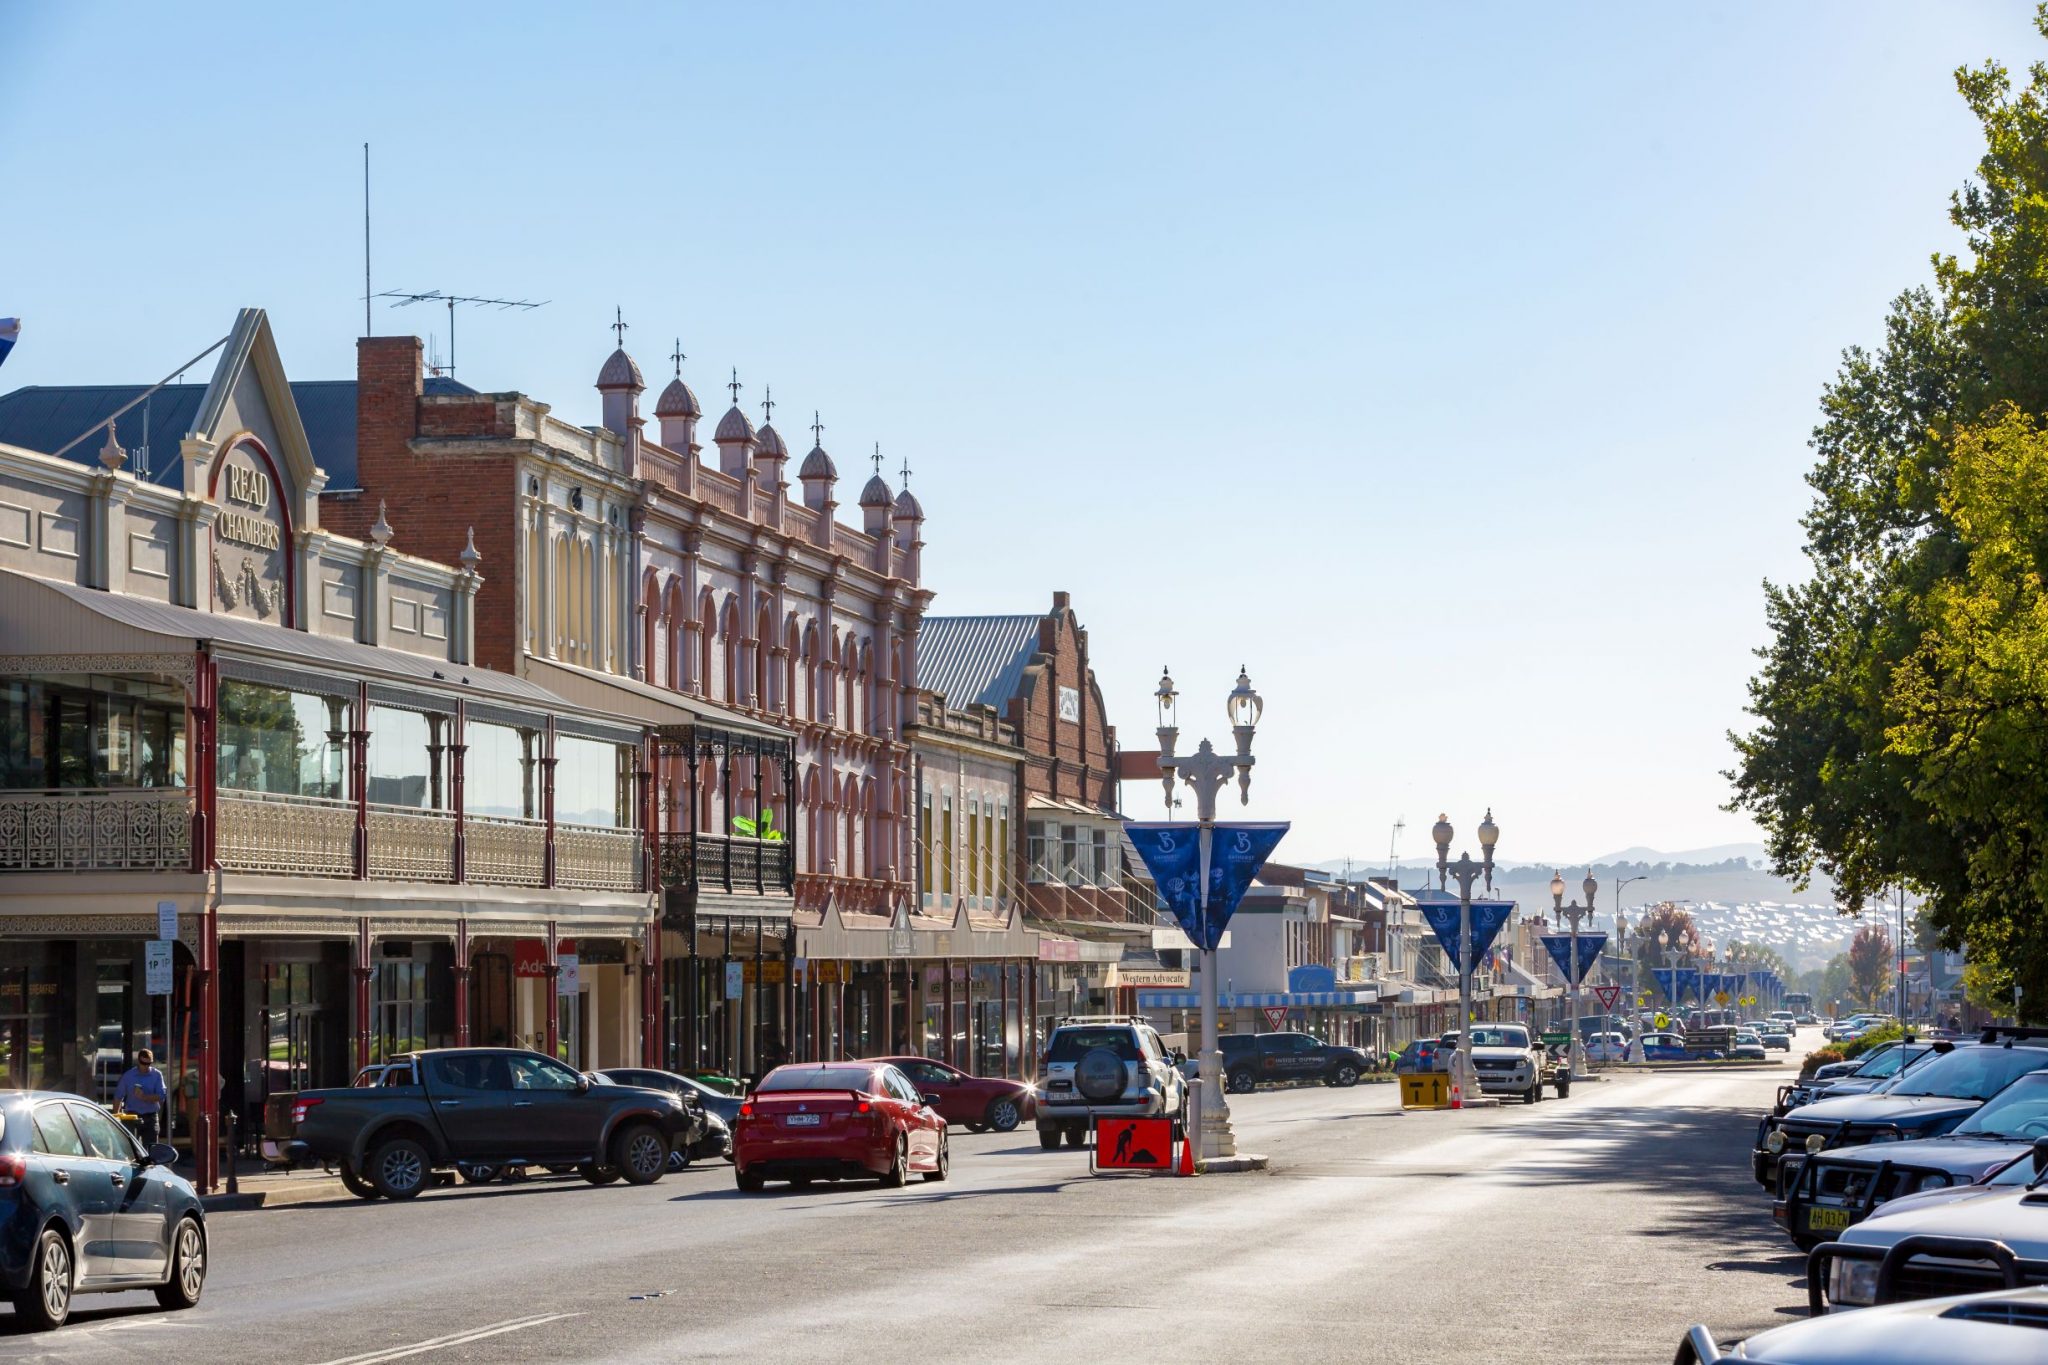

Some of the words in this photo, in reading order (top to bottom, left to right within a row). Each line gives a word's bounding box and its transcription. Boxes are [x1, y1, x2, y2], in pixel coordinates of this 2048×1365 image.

[228, 463, 270, 507] READ
[219, 510, 280, 551] CHAMBERS
[1122, 973, 1151, 983] Western
[1152, 973, 1184, 983] Advocate
[1811, 1208, 1823, 1224] AH
